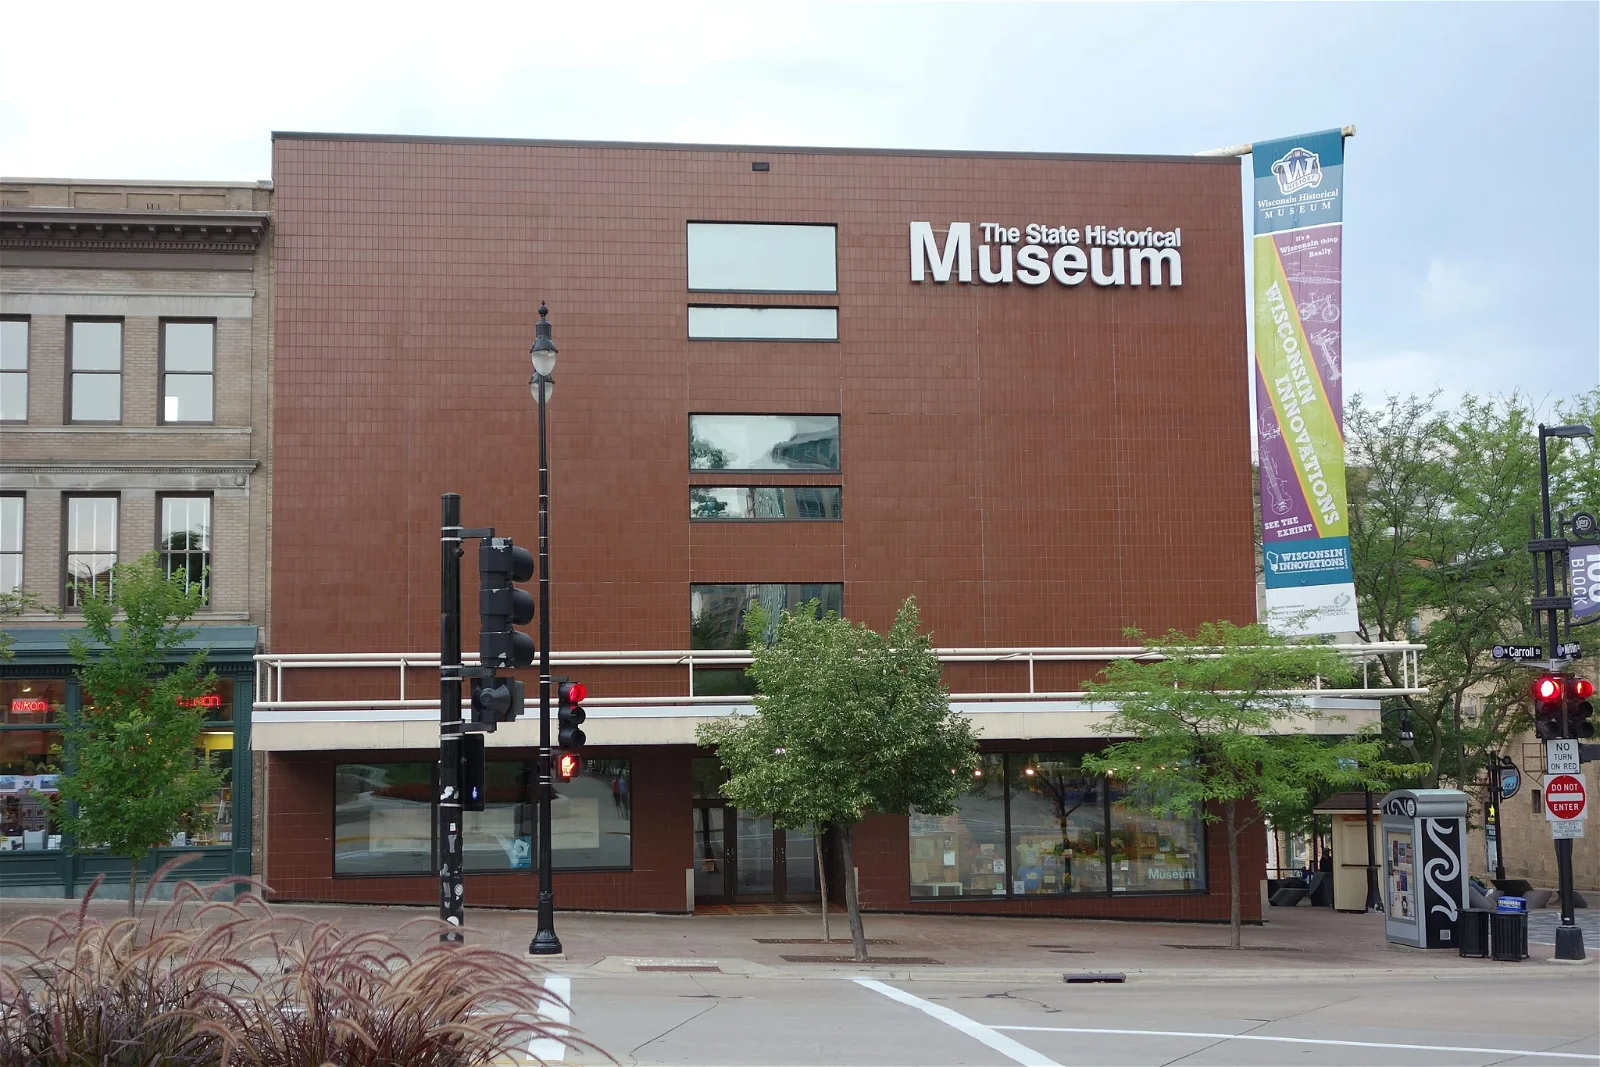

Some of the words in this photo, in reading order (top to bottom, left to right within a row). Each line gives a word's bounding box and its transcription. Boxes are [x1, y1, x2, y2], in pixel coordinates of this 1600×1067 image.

[1274, 155, 1317, 184] W
[1286, 174, 1315, 190] HISTORY
[1258, 195, 1297, 209] Wisconsin
[1298, 188, 1339, 202] Historical
[1264, 201, 1331, 219] MUSEUM
[979, 222, 1020, 244] The
[1026, 223, 1080, 245] State
[1085, 225, 1181, 248] Historical
[910, 221, 1183, 287] Museum
[1280, 240, 1319, 254] Wisconsin
[1265, 280, 1317, 405] WISCONSIN
[1274, 373, 1341, 526] INNOVATIONS
[1264, 520, 1280, 530] SEE
[1280, 516, 1299, 527] THE
[1277, 524, 1313, 538] EXHIBIT
[1281, 548, 1343, 561] WISCONSIN
[1279, 557, 1345, 571] INNOVATIONS
[1571, 558, 1588, 605] BLOCK
[1508, 646, 1534, 657] Carroll
[1556, 742, 1570, 751] NO
[1554, 753, 1573, 761] TURN
[1563, 762, 1578, 770] RED
[1551, 783, 1562, 791] DO
[1563, 783, 1578, 791] NOT
[1553, 803, 1579, 811] ENTER
[1148, 868, 1196, 879] Museum
